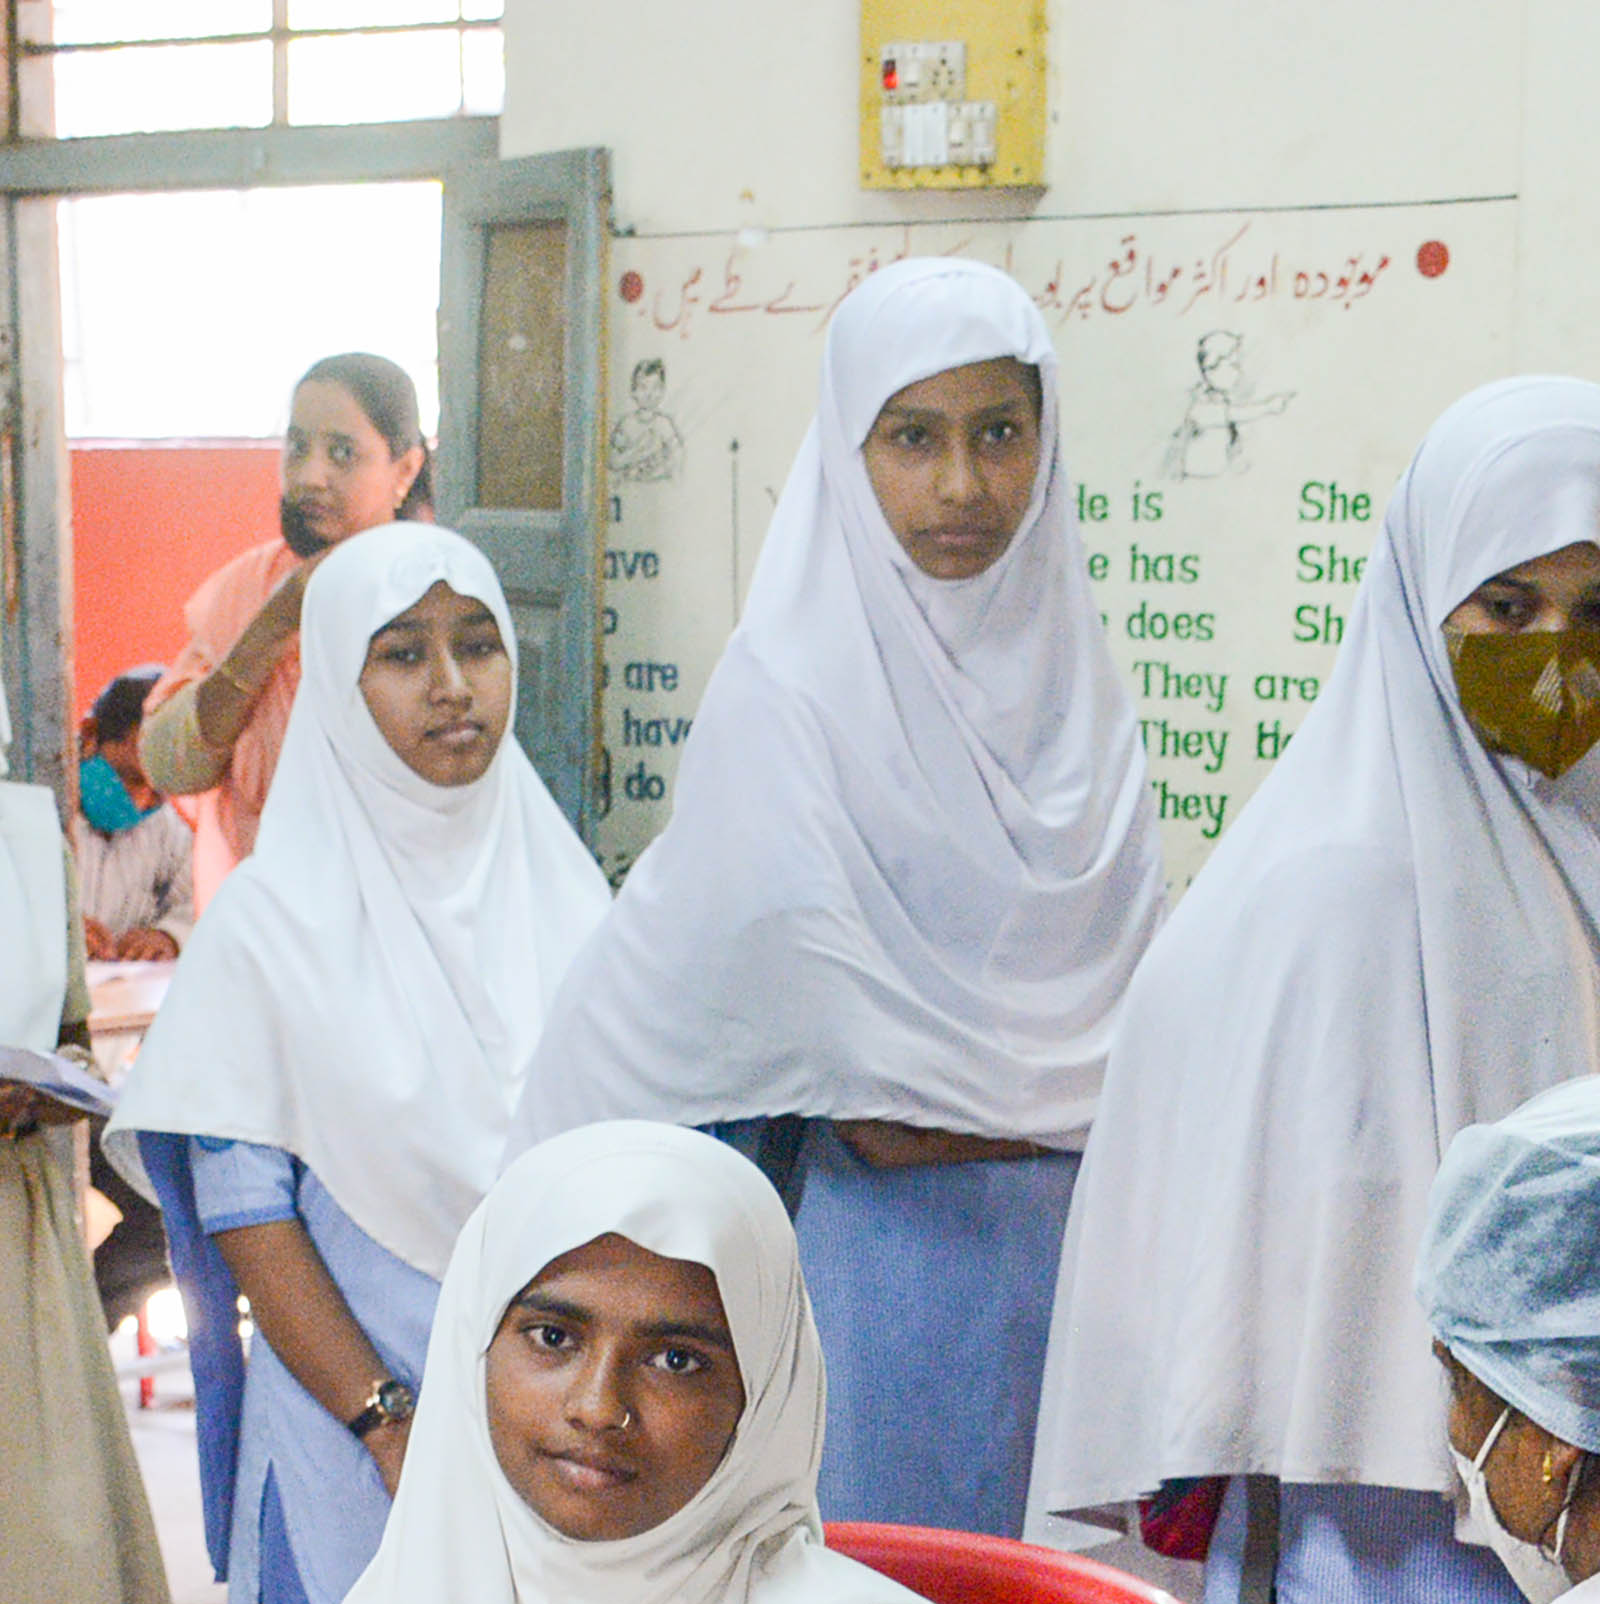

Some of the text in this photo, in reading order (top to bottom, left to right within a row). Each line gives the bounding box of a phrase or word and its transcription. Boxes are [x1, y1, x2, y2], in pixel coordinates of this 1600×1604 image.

[1099, 232, 1182, 316] مواقع
[1233, 250, 1281, 304] اور
[1132, 479, 1164, 522] is
[1298, 480, 1372, 523] She
[603, 549, 660, 582] ave
[1128, 542, 1201, 584] has
[1125, 600, 1217, 642] does
[623, 660, 679, 693] are
[1132, 659, 1321, 713] They are
[623, 760, 666, 801] do
[1151, 779, 1229, 839] hey
